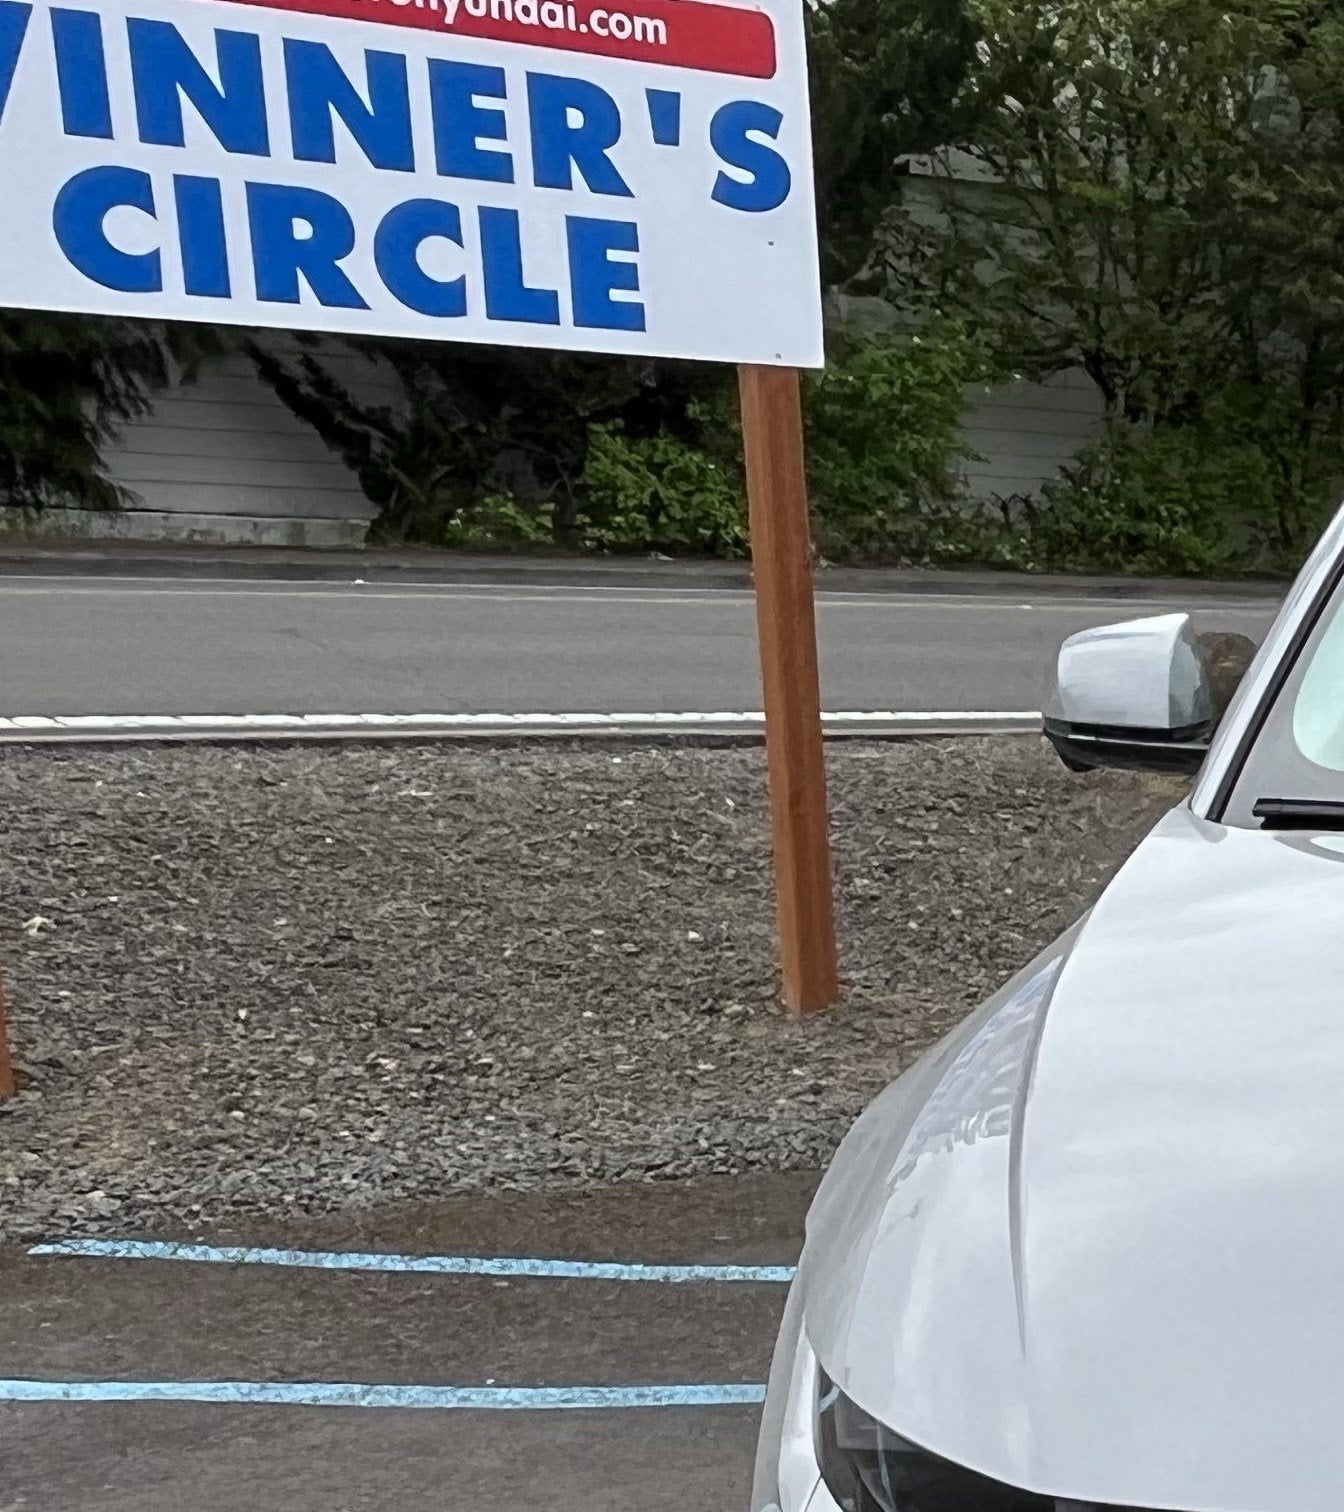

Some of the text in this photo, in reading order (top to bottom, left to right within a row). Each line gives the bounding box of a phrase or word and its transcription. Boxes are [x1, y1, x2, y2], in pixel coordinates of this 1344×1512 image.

[0, 0, 792, 212] INNER'S
[368, 0, 668, 45] yundai.com
[52, 165, 647, 333] CIRCLE
